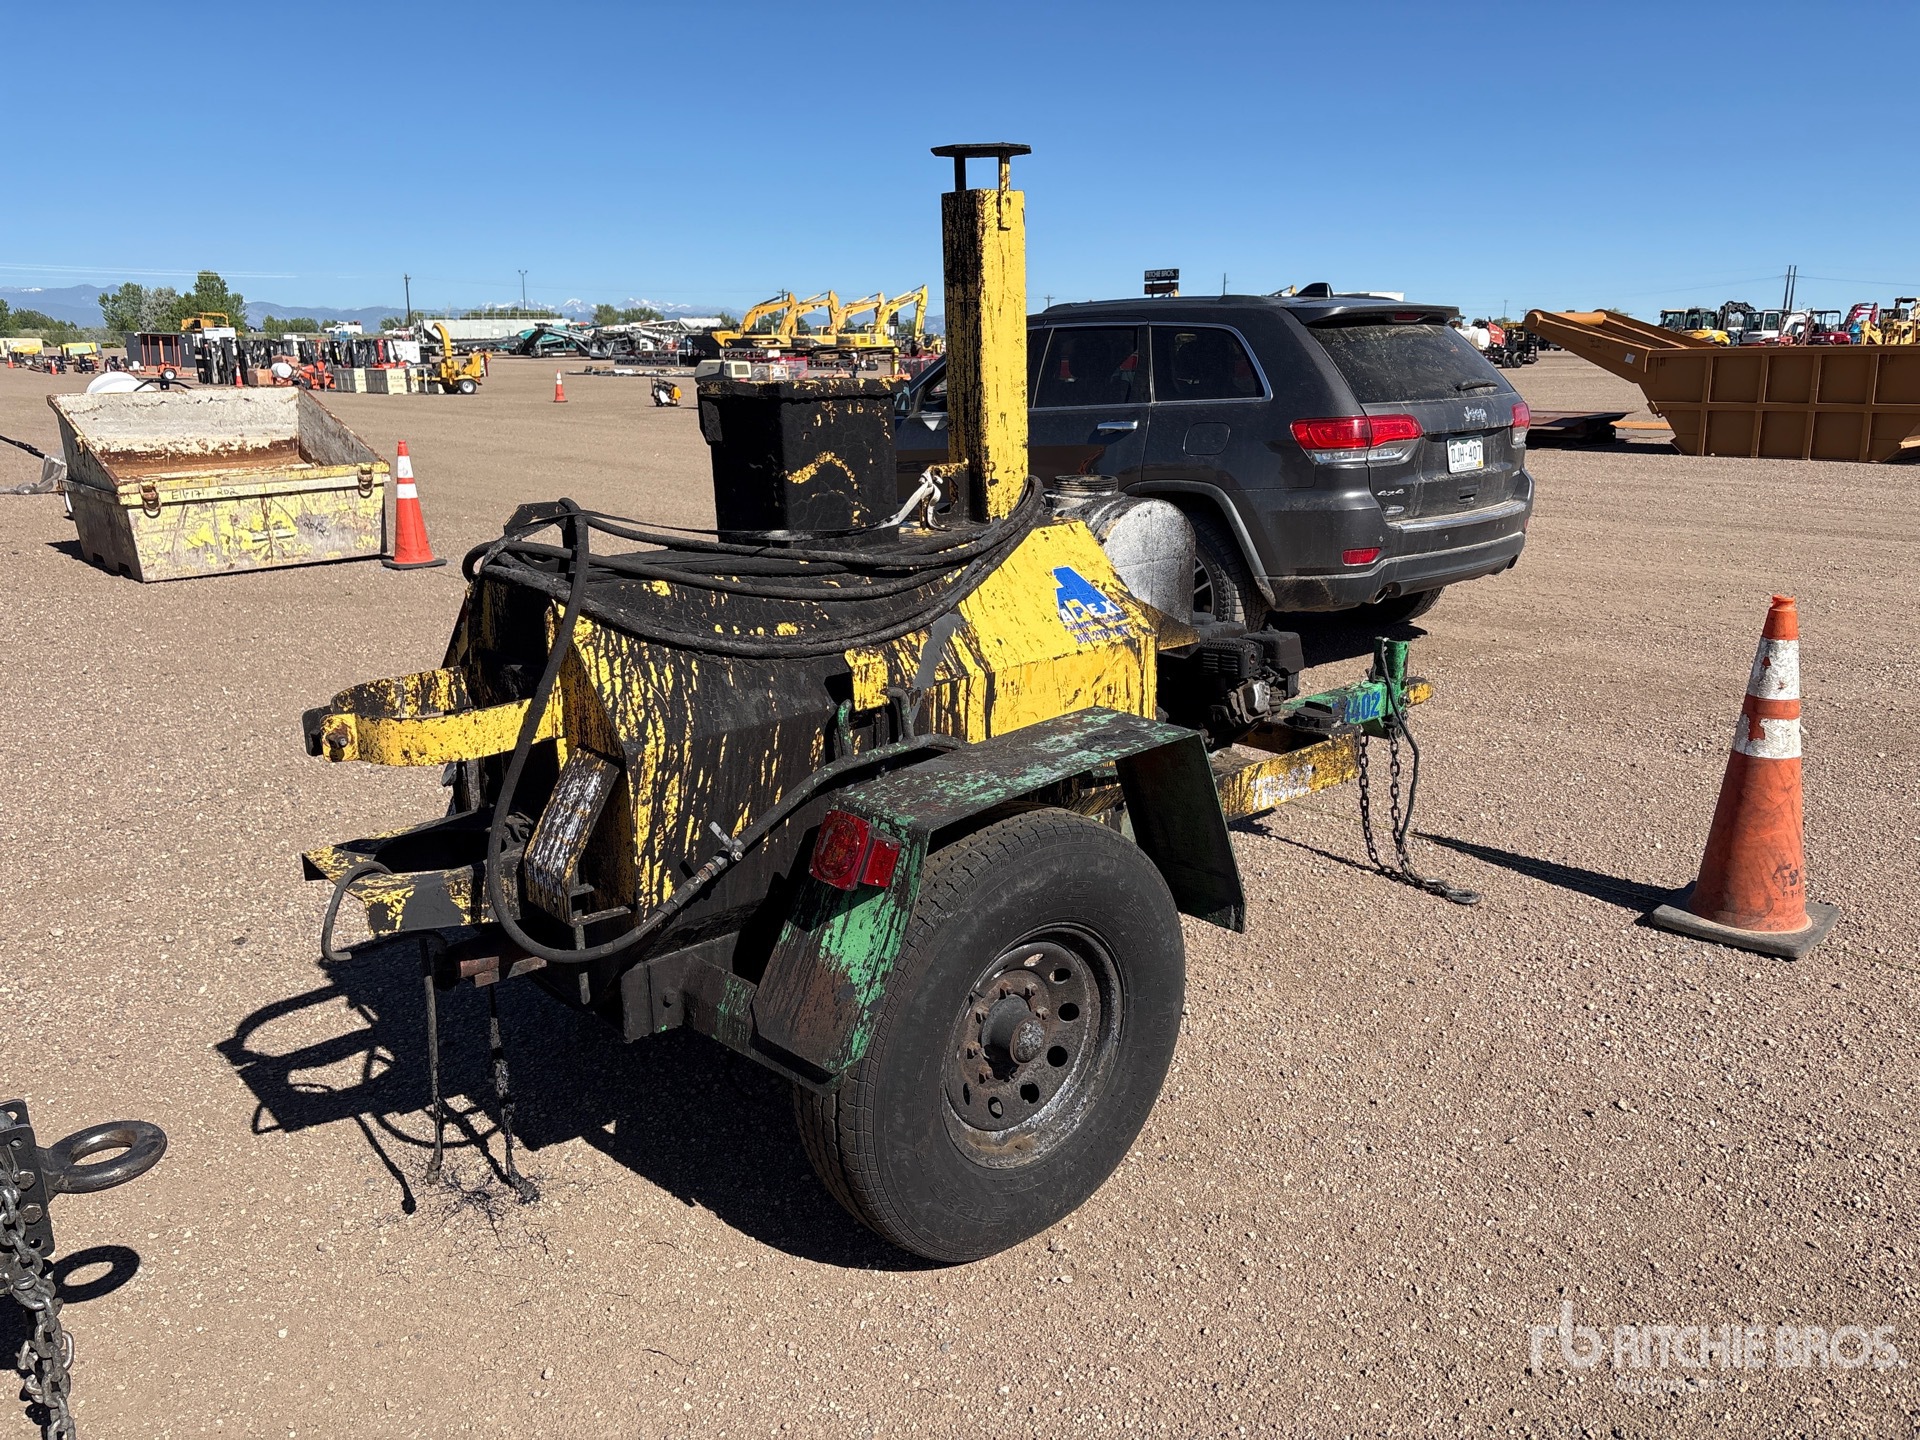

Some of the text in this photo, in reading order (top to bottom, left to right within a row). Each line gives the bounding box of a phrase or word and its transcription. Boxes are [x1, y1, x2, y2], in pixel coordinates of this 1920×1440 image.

[1463, 406, 1487, 422] Jeep
[1377, 488, 1405, 497] 4x4
[1059, 600, 1118, 623] APEX
